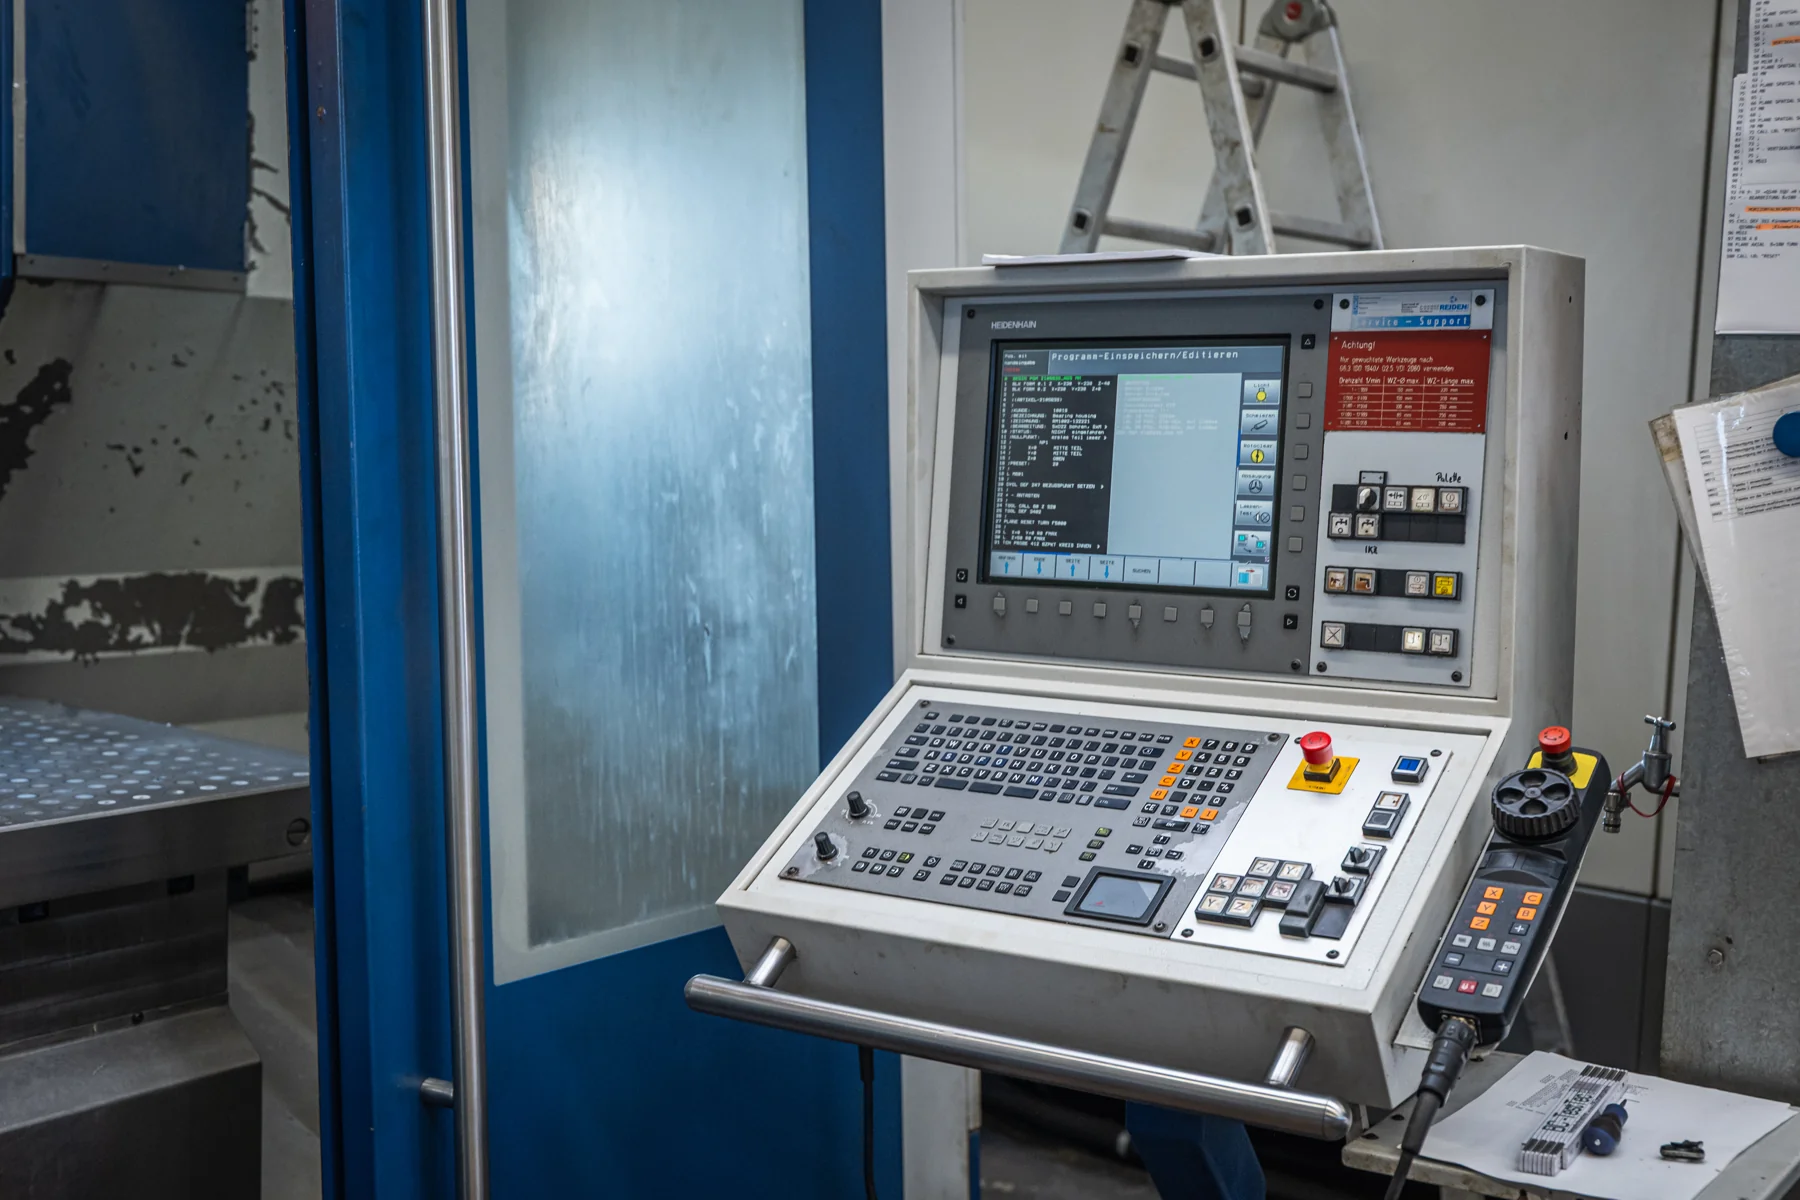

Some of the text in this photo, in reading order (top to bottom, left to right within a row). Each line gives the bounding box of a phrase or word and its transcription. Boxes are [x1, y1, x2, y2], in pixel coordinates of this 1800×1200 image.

[991, 320, 1037, 330] HEIDENHAIN
[1420, 316, 1467, 328] Support
[1341, 341, 1376, 352] Achtung!
[1386, 356, 1417, 364] Werkzeuge
[1436, 472, 1462, 484] Palette
